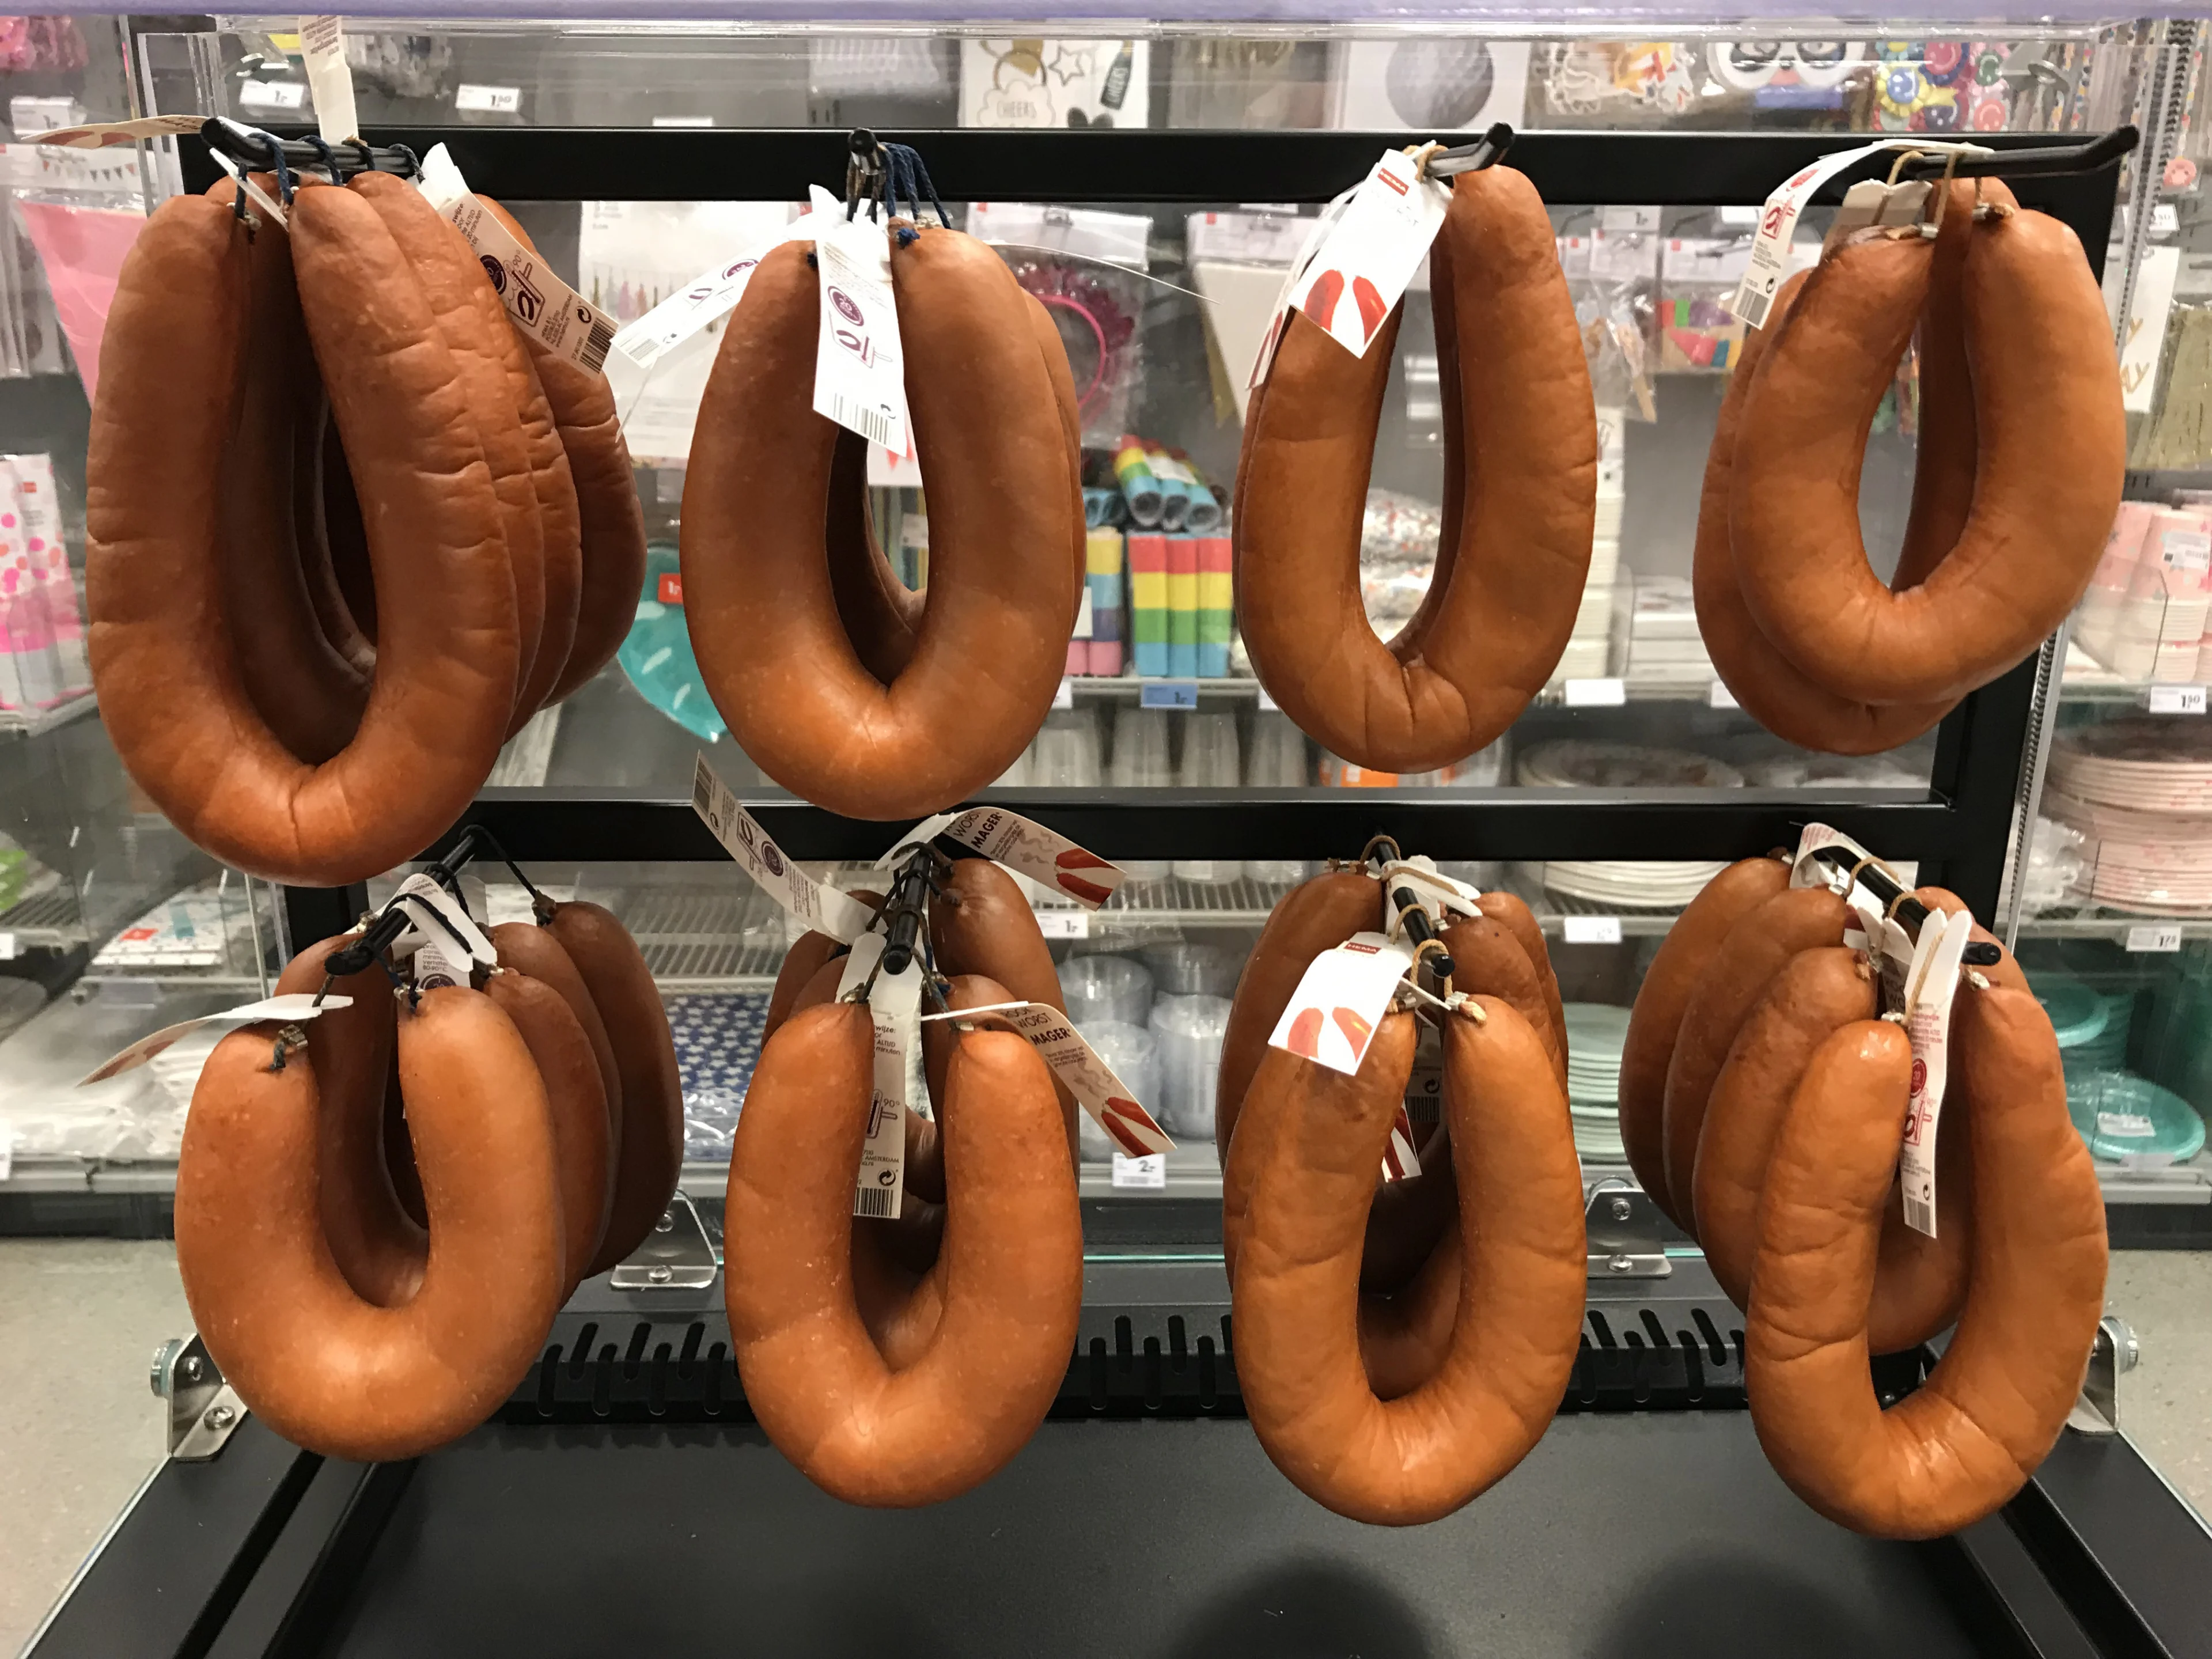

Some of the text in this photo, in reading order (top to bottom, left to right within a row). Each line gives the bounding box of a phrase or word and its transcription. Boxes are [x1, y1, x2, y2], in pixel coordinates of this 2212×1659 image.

[471, 210, 482, 233] minuten
[1347, 944, 1376, 952] HEMA
[1014, 1012, 1052, 1029] WORST
[877, 1039, 896, 1048] ALTIJD
[876, 1047, 900, 1055] minuten
[884, 1098, 900, 1107] 90°
